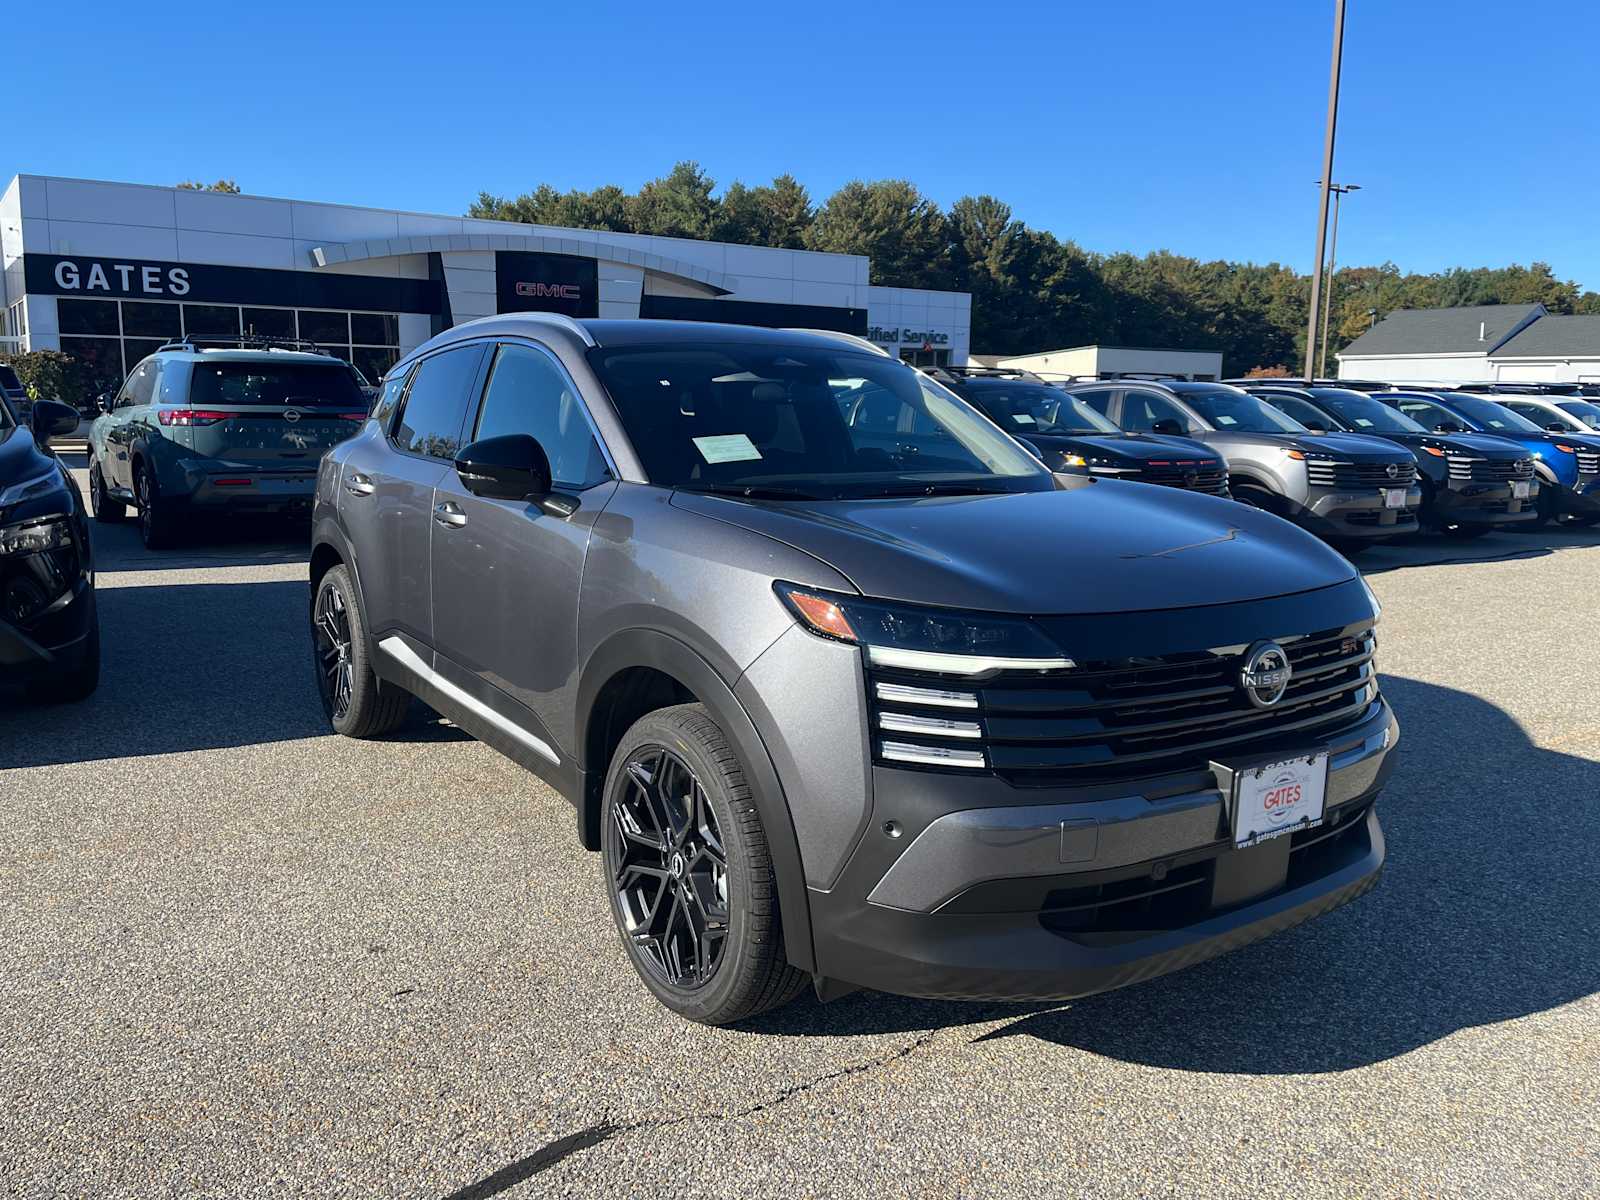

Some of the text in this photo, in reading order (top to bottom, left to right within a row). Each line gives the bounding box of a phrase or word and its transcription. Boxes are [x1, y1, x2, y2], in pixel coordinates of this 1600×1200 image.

[54, 261, 190, 295] GATES
[515, 281, 581, 299] GMC
[903, 328, 948, 344] Service
[1263, 784, 1302, 810] GATES
